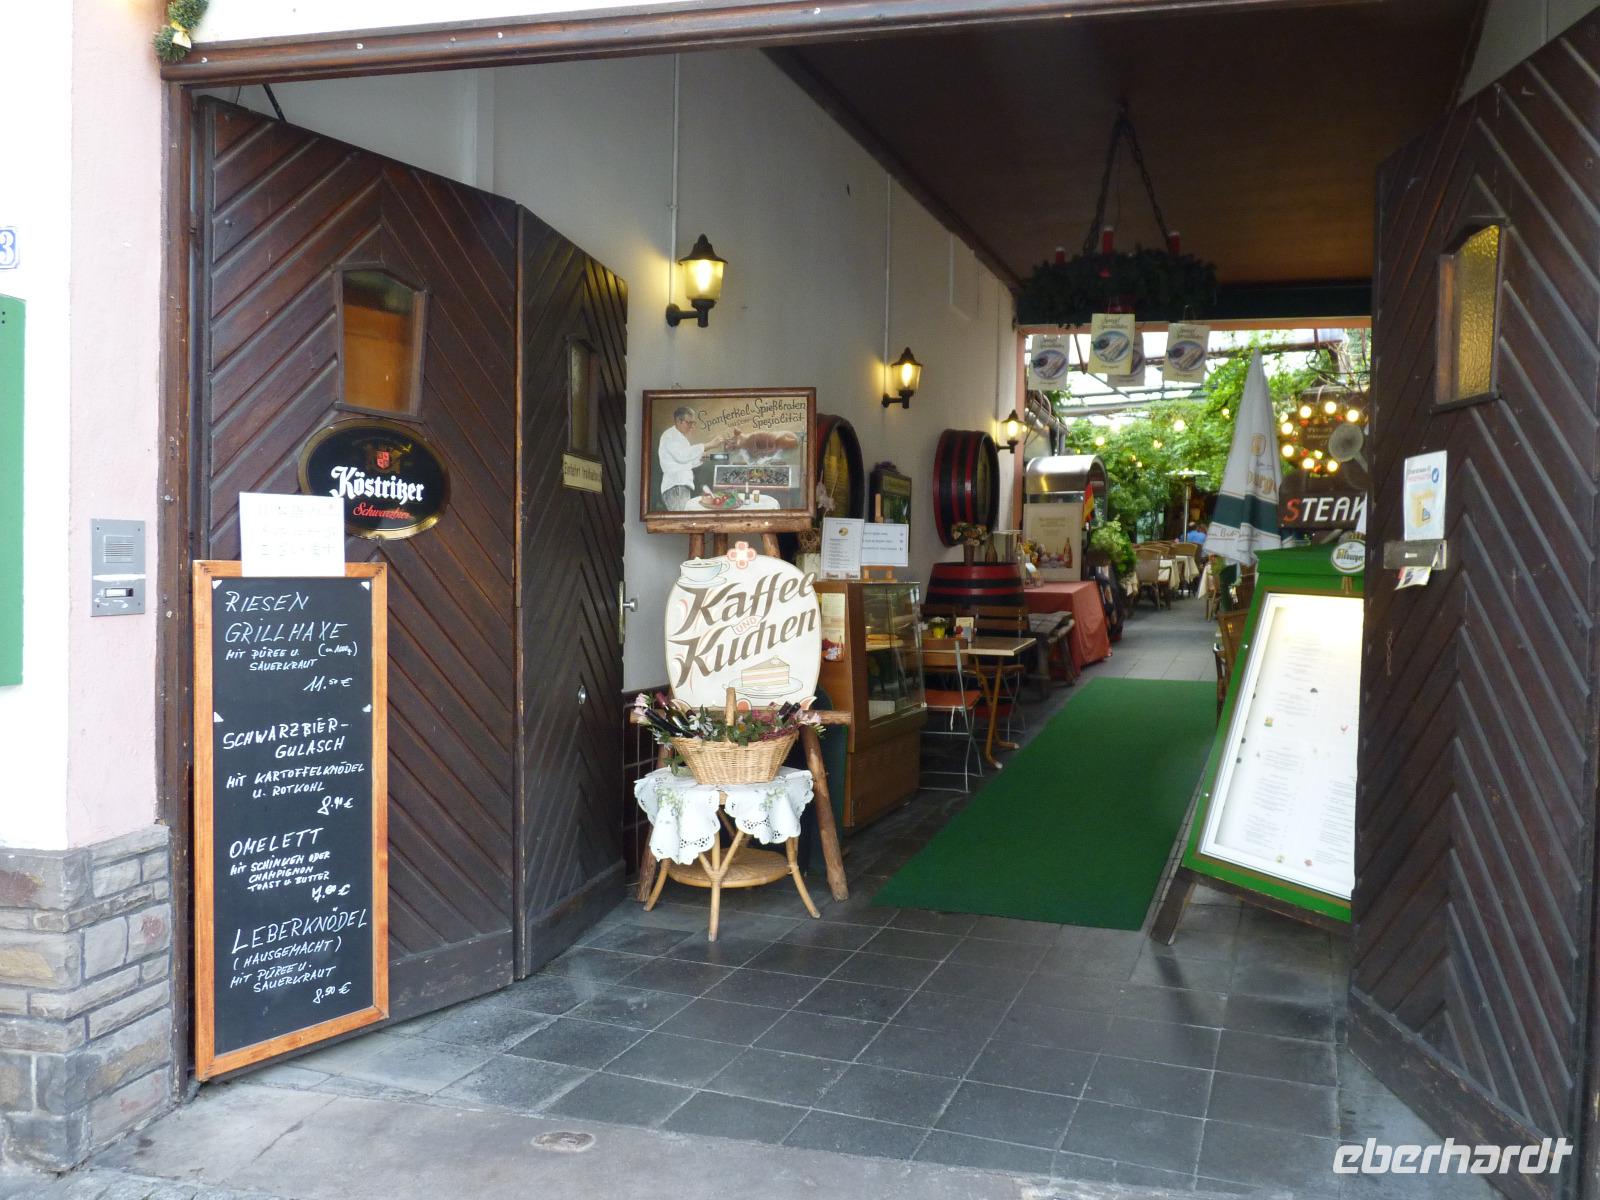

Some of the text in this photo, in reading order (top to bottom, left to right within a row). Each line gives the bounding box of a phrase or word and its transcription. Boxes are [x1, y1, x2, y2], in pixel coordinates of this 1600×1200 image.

[698, 402, 750, 431] Spanferkel
[754, 398, 806, 418] Spießbraten
[329, 465, 425, 506] Köstritzer
[225, 590, 309, 613] RIESEN
[671, 571, 818, 637] Kaffee
[225, 617, 348, 644] GRILLHAXE
[736, 617, 758, 633] UND
[251, 646, 288, 660] PÜREE
[667, 607, 817, 690] Kuchen
[249, 658, 318, 671] SAUERKRAUT
[340, 677, 353, 687] €
[222, 717, 350, 750] SCHWARZBIER-
[275, 735, 346, 759] GULASCH
[226, 760, 365, 789] MIT KARTOFFELKNÖDEL
[271, 781, 325, 797] ROTKOHL
[229, 827, 325, 859] OMELETT
[250, 854, 305, 872] SCHINKEN
[308, 850, 331, 863] ODER
[247, 880, 281, 892] TOAST
[295, 870, 330, 885] BUTTER
[248, 866, 314, 884] CHAMPIGNON
[231, 906, 367, 954] LEBERKNÖDEL
[253, 965, 337, 993] SAUERKRAUT
[257, 962, 298, 981] PÜREE
[338, 981, 352, 995] €
